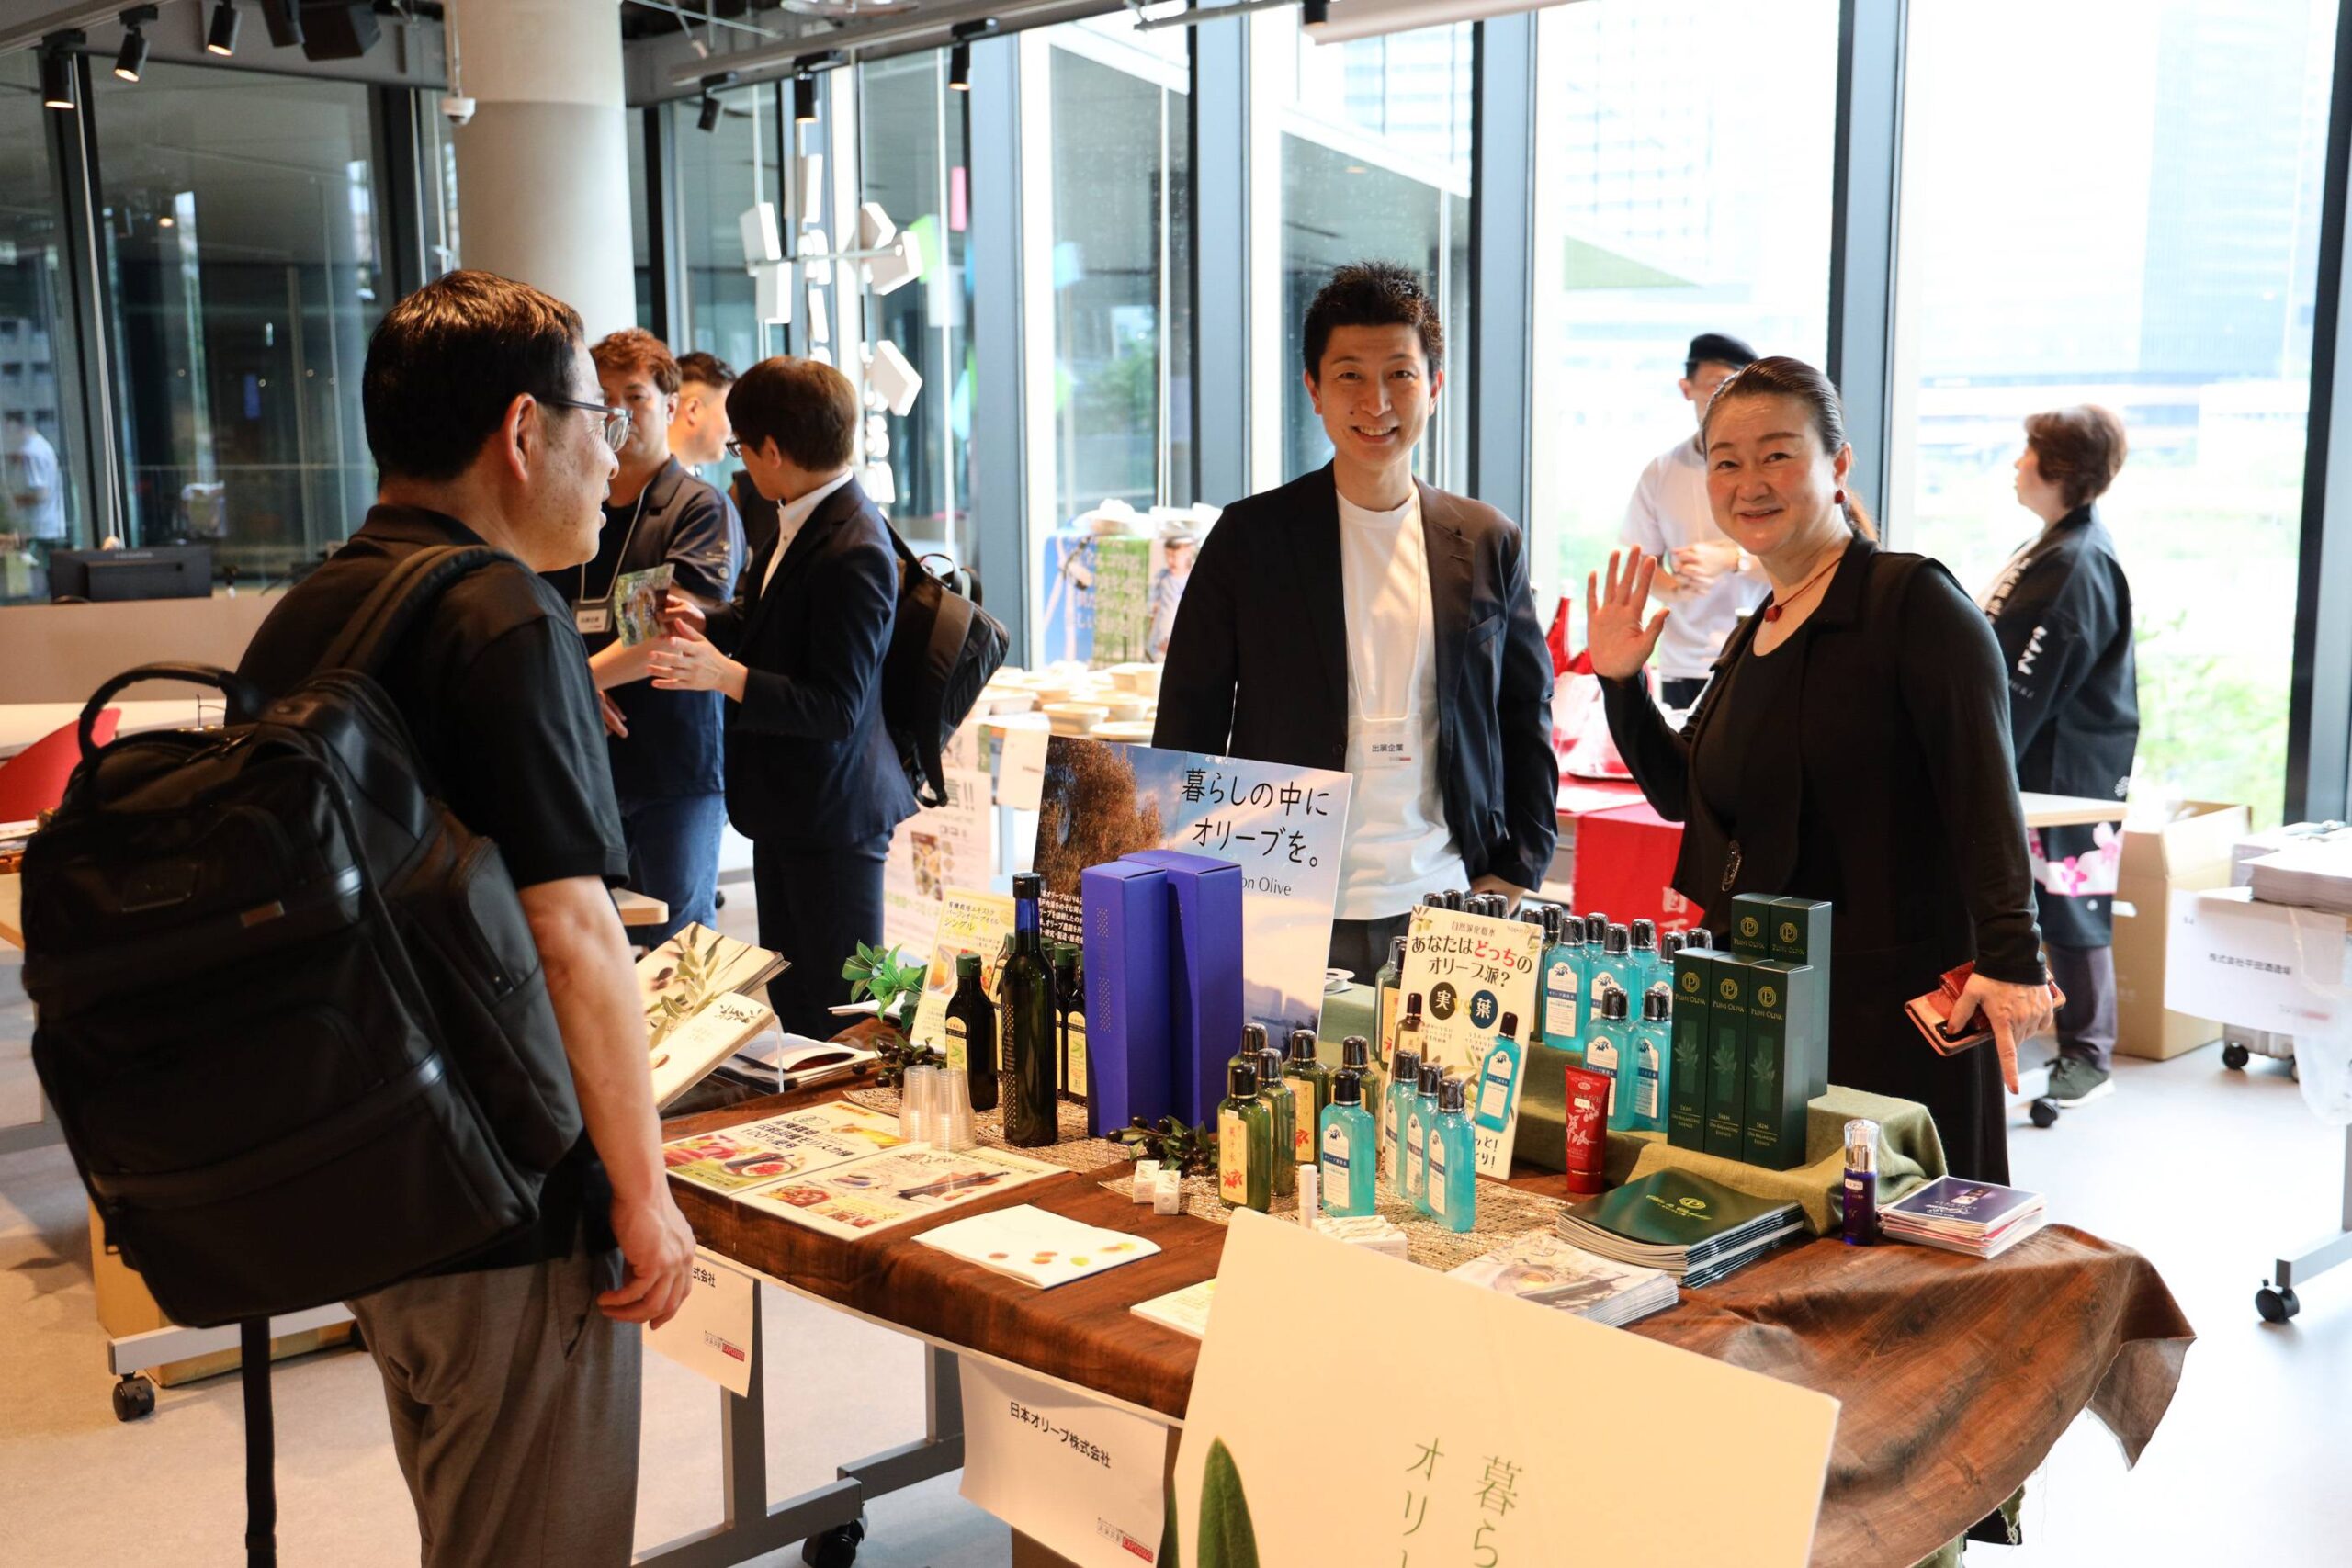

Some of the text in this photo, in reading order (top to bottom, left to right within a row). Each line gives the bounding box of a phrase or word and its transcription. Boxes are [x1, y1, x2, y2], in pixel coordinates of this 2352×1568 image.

[1182, 767, 1330, 817] 暮らしの中に
[1192, 817, 1318, 868] オリーブを。
[1259, 877, 1293, 896] Olive
[1411, 934, 1532, 974] あなたはどっちの
[1435, 990, 1452, 1010] 実
[1476, 998, 1492, 1020] 葉
[1009, 1401, 1112, 1469] 日本オリーブ株式会社
[1474, 1455, 1522, 1568] 暮ら
